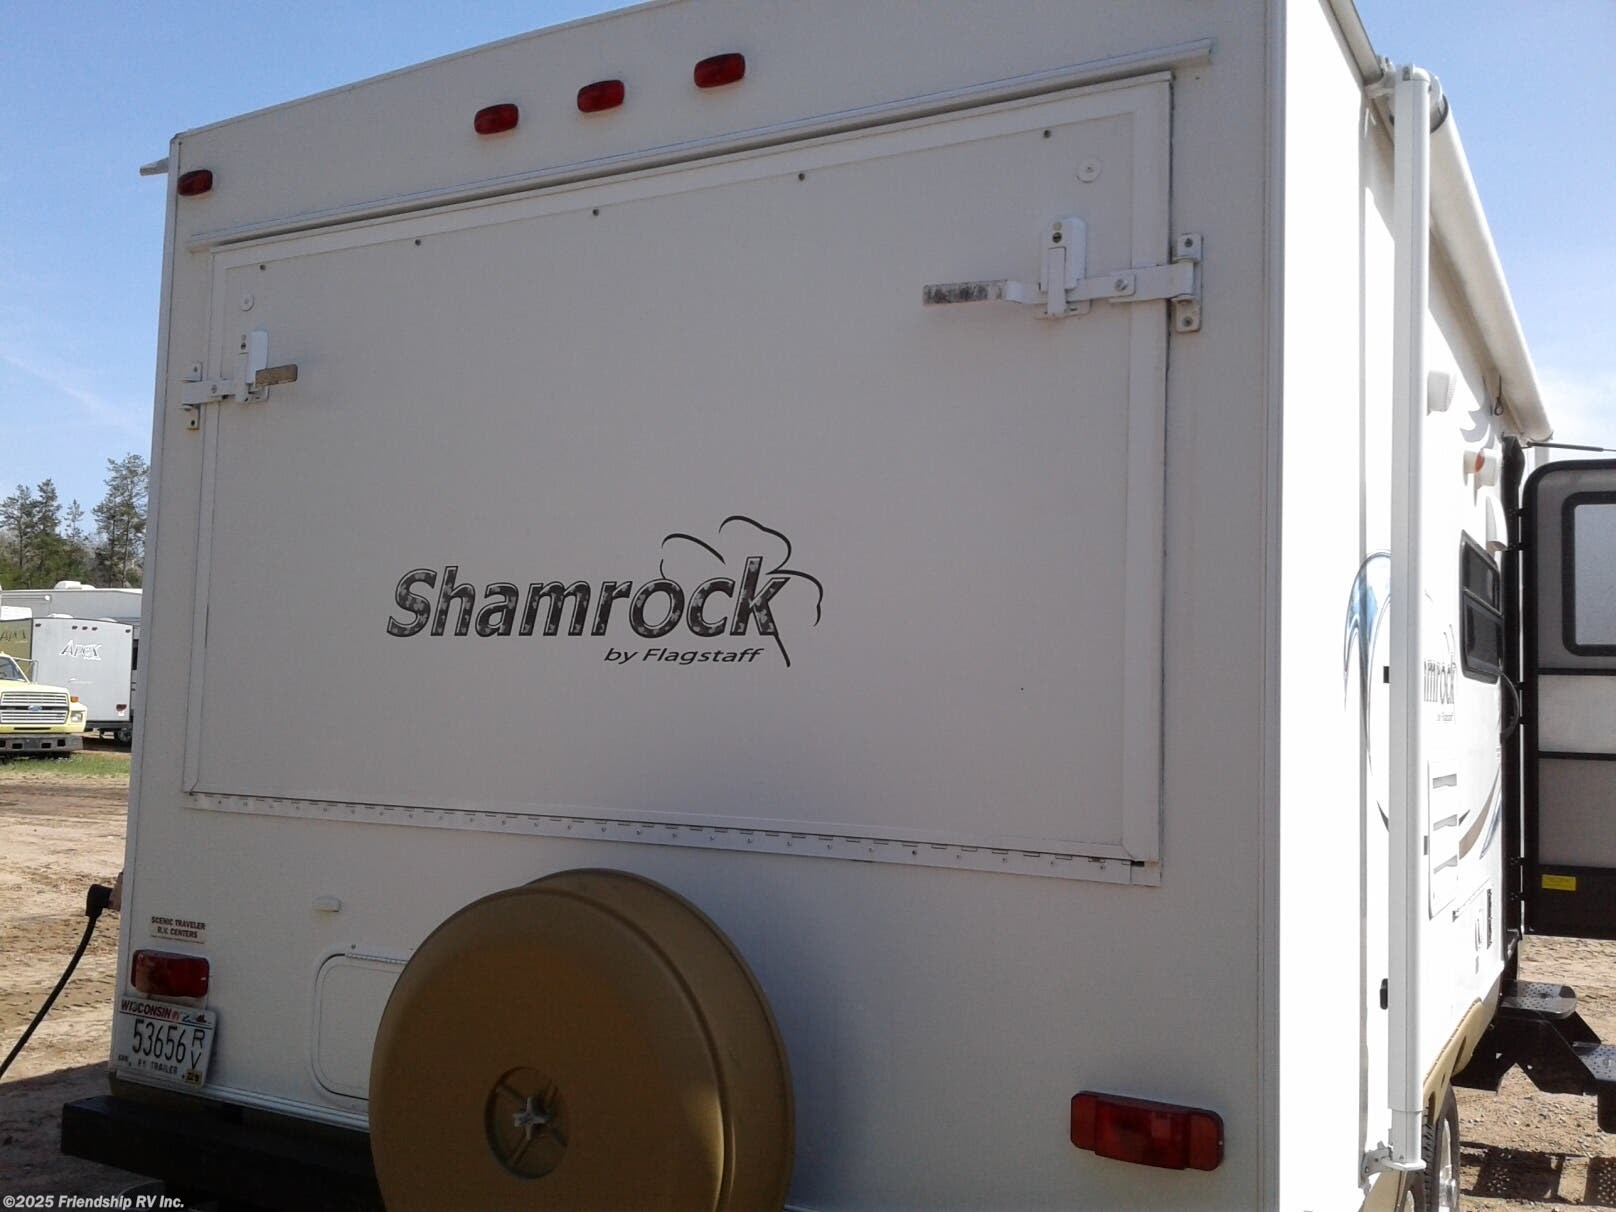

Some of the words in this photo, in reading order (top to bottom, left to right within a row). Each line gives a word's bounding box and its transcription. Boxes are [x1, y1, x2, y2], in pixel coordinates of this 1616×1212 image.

[386, 556, 791, 639] Shamrock
[604, 647, 638, 665] by
[642, 647, 765, 666] Flagstaff
[151, 916, 174, 926] SCENIC
[175, 919, 206, 930] TRAVELER
[170, 928, 198, 939] CENTERS
[121, 999, 172, 1019] WISCONSIN
[132, 1018, 188, 1064] 53656
